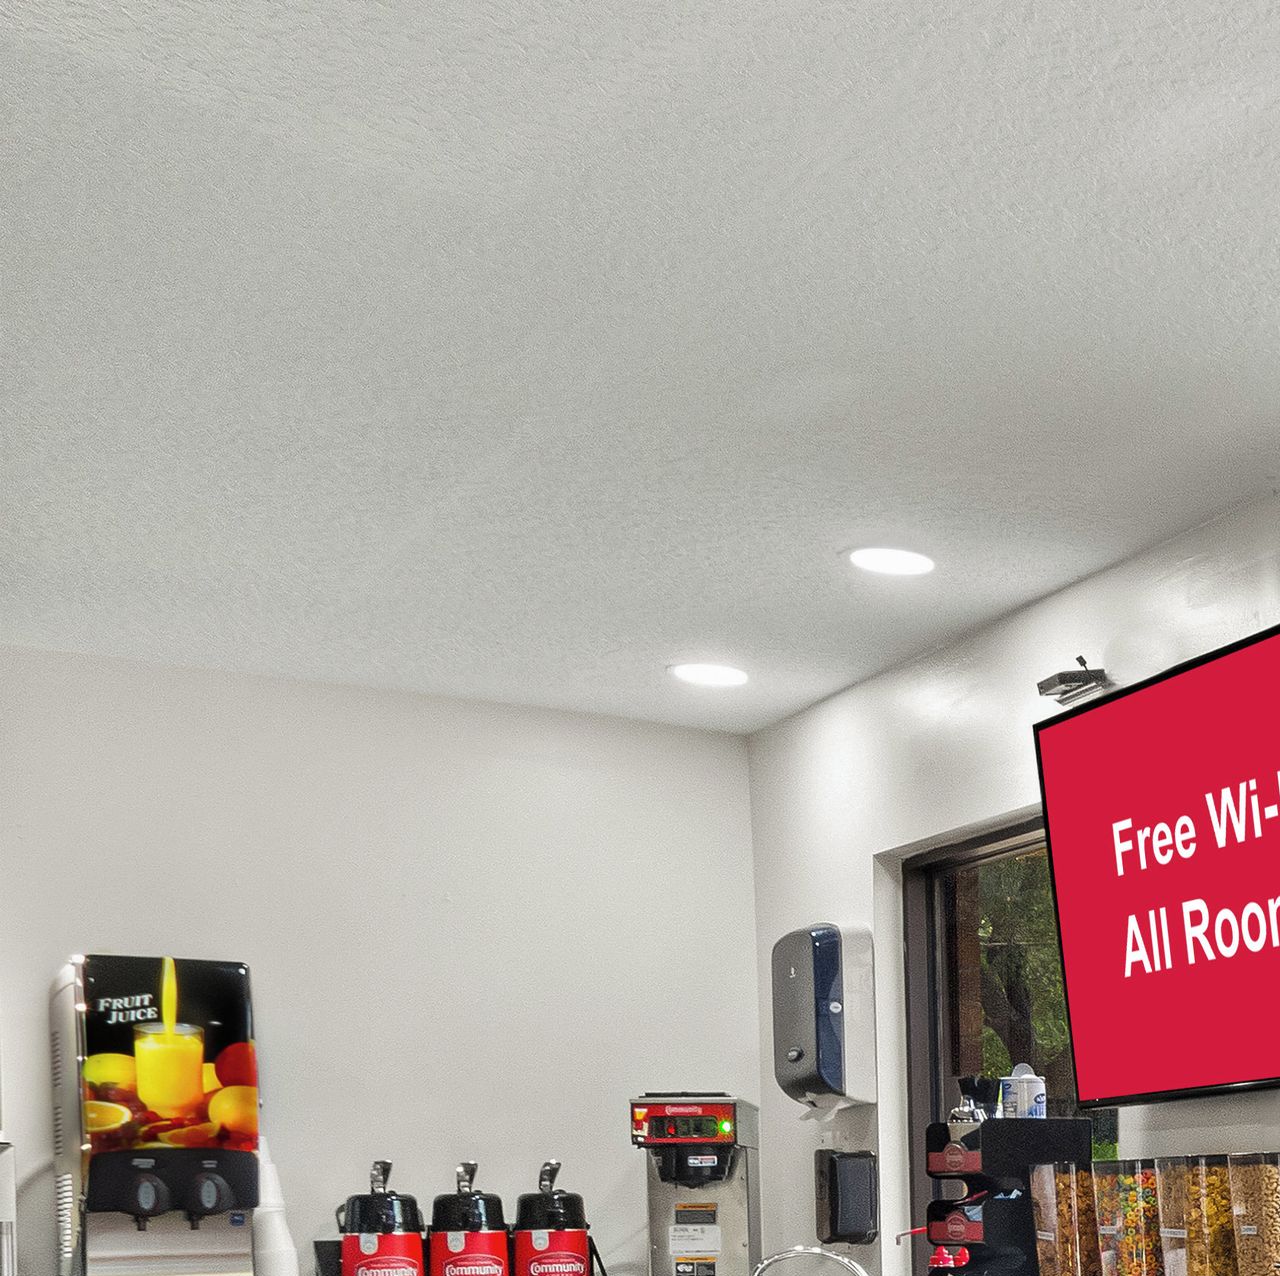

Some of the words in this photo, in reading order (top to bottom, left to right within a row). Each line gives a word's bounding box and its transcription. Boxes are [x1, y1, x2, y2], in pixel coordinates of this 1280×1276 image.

[1112, 814, 1196, 876] Free
[1124, 906, 1173, 978] All
[99, 993, 153, 1013] FRUIT
[107, 1006, 158, 1025] JUICE
[530, 1261, 586, 1276] Community
